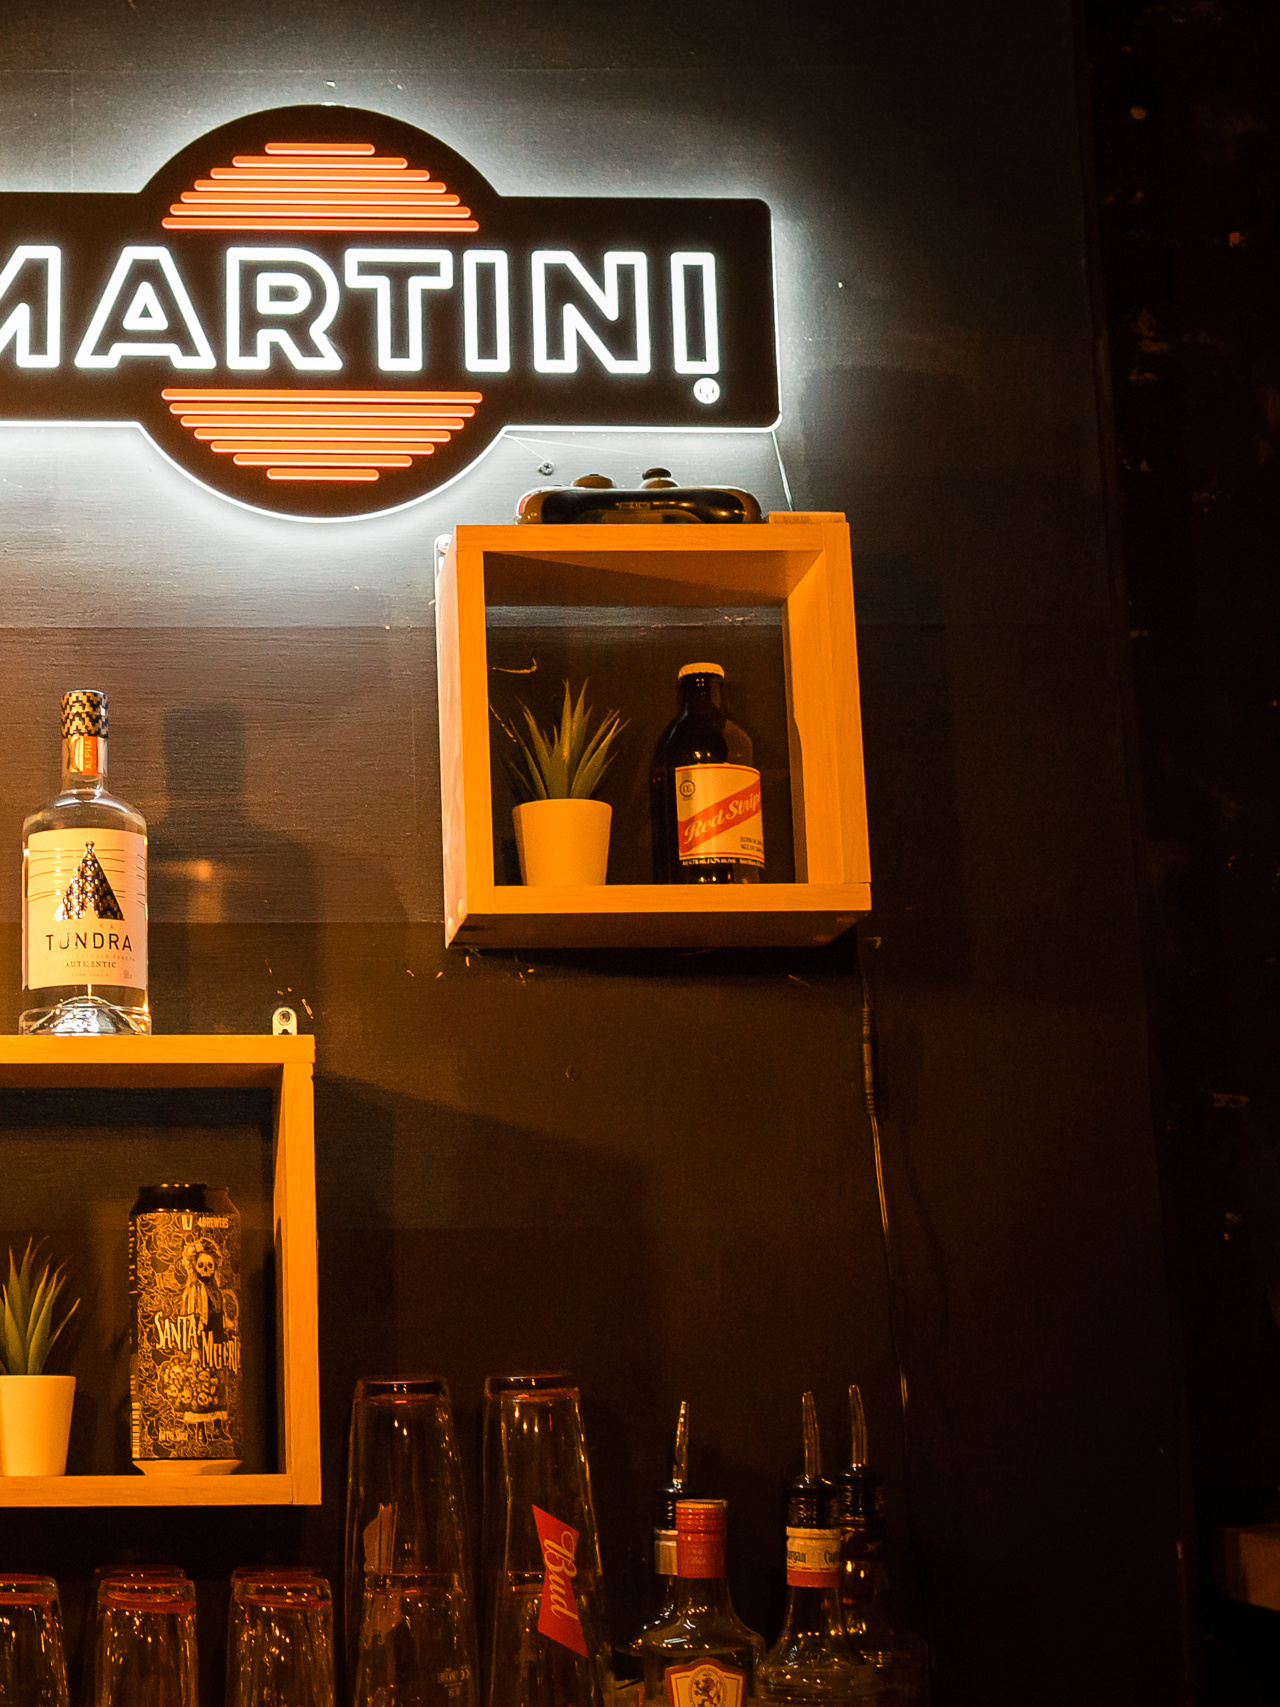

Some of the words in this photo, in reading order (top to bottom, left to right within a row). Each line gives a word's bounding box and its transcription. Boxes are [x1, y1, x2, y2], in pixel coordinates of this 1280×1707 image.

[84, 739, 93, 770] ALPHA
[684, 810, 725, 845] Red
[725, 792, 761, 820] Strip
[45, 932, 132, 952] TUNDRA
[154, 1311, 199, 1354] SANTA
[543, 1530, 579, 1620] Bud
